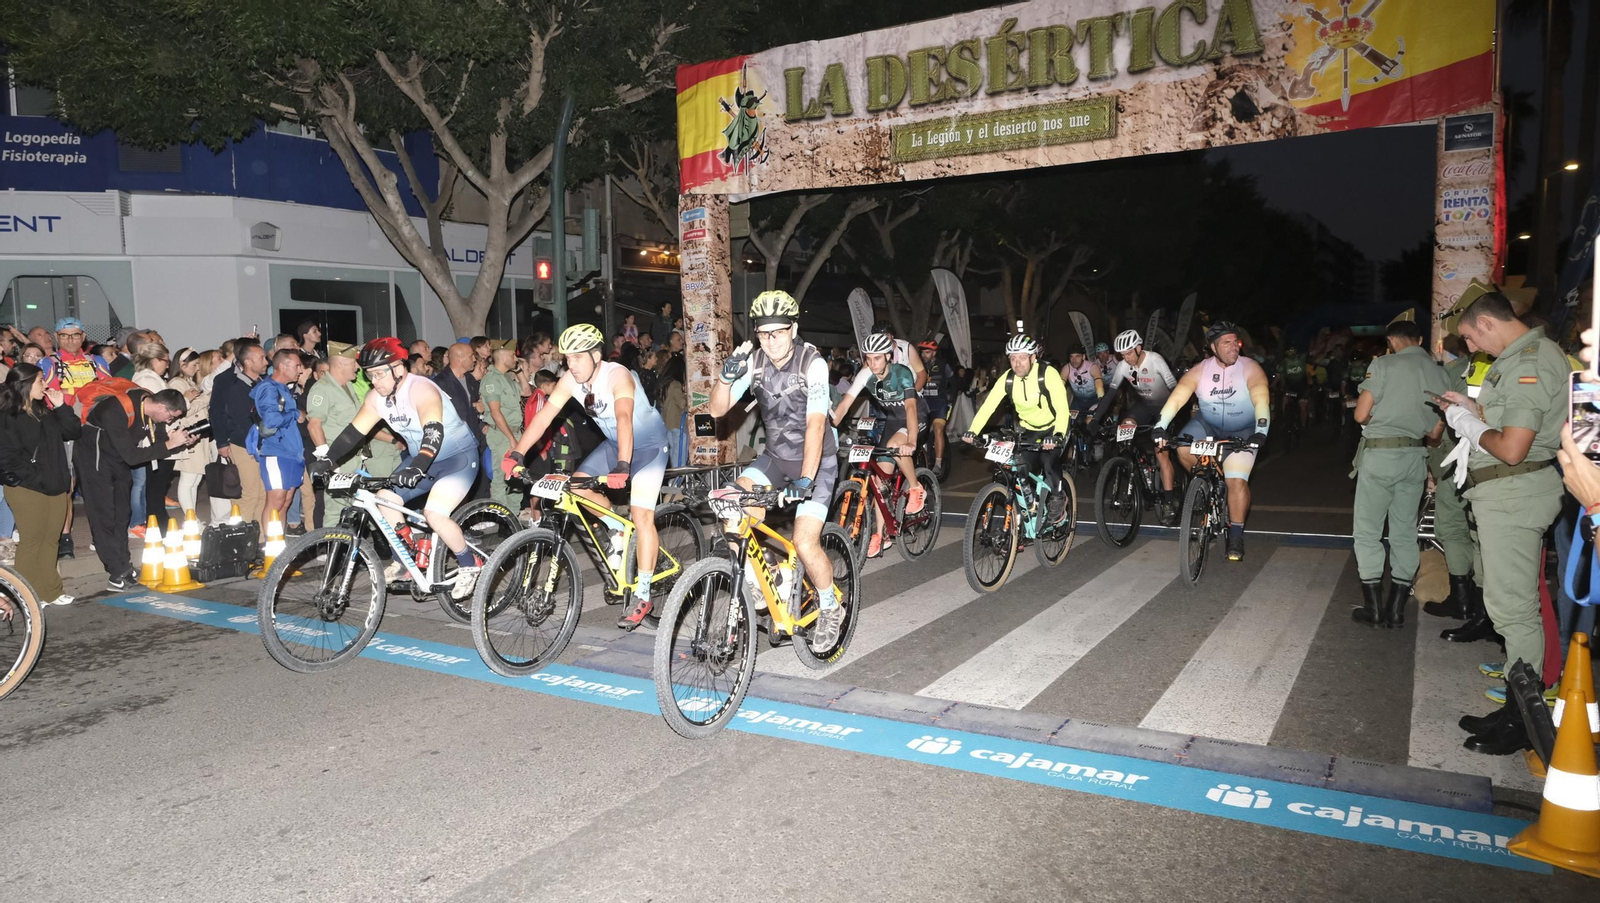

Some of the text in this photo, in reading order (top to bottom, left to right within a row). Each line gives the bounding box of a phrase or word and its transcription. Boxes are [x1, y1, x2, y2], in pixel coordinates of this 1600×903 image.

[784, 0, 1265, 124] LA DESÉRTICA
[4, 131, 82, 147] Logopedia
[911, 114, 1091, 148] La Legión y el desierto nos une
[1454, 132, 1482, 140] SENATOR
[1, 149, 88, 166] Fisioterapia
[1444, 188, 1488, 197] GRUPO
[1443, 196, 1489, 209] RENTA
[852, 449, 870, 457] 7295
[1194, 441, 1215, 450] 6179
[538, 480, 562, 491] 6680
[376, 642, 471, 665] cajamar
[530, 671, 644, 698] cajamar
[737, 708, 864, 736] ajamar
[778, 725, 846, 741] CAJA RURAL
[970, 748, 1150, 786] cajamar
[1047, 770, 1137, 791] CAJA RURAL
[1396, 831, 1446, 845] CAJA
